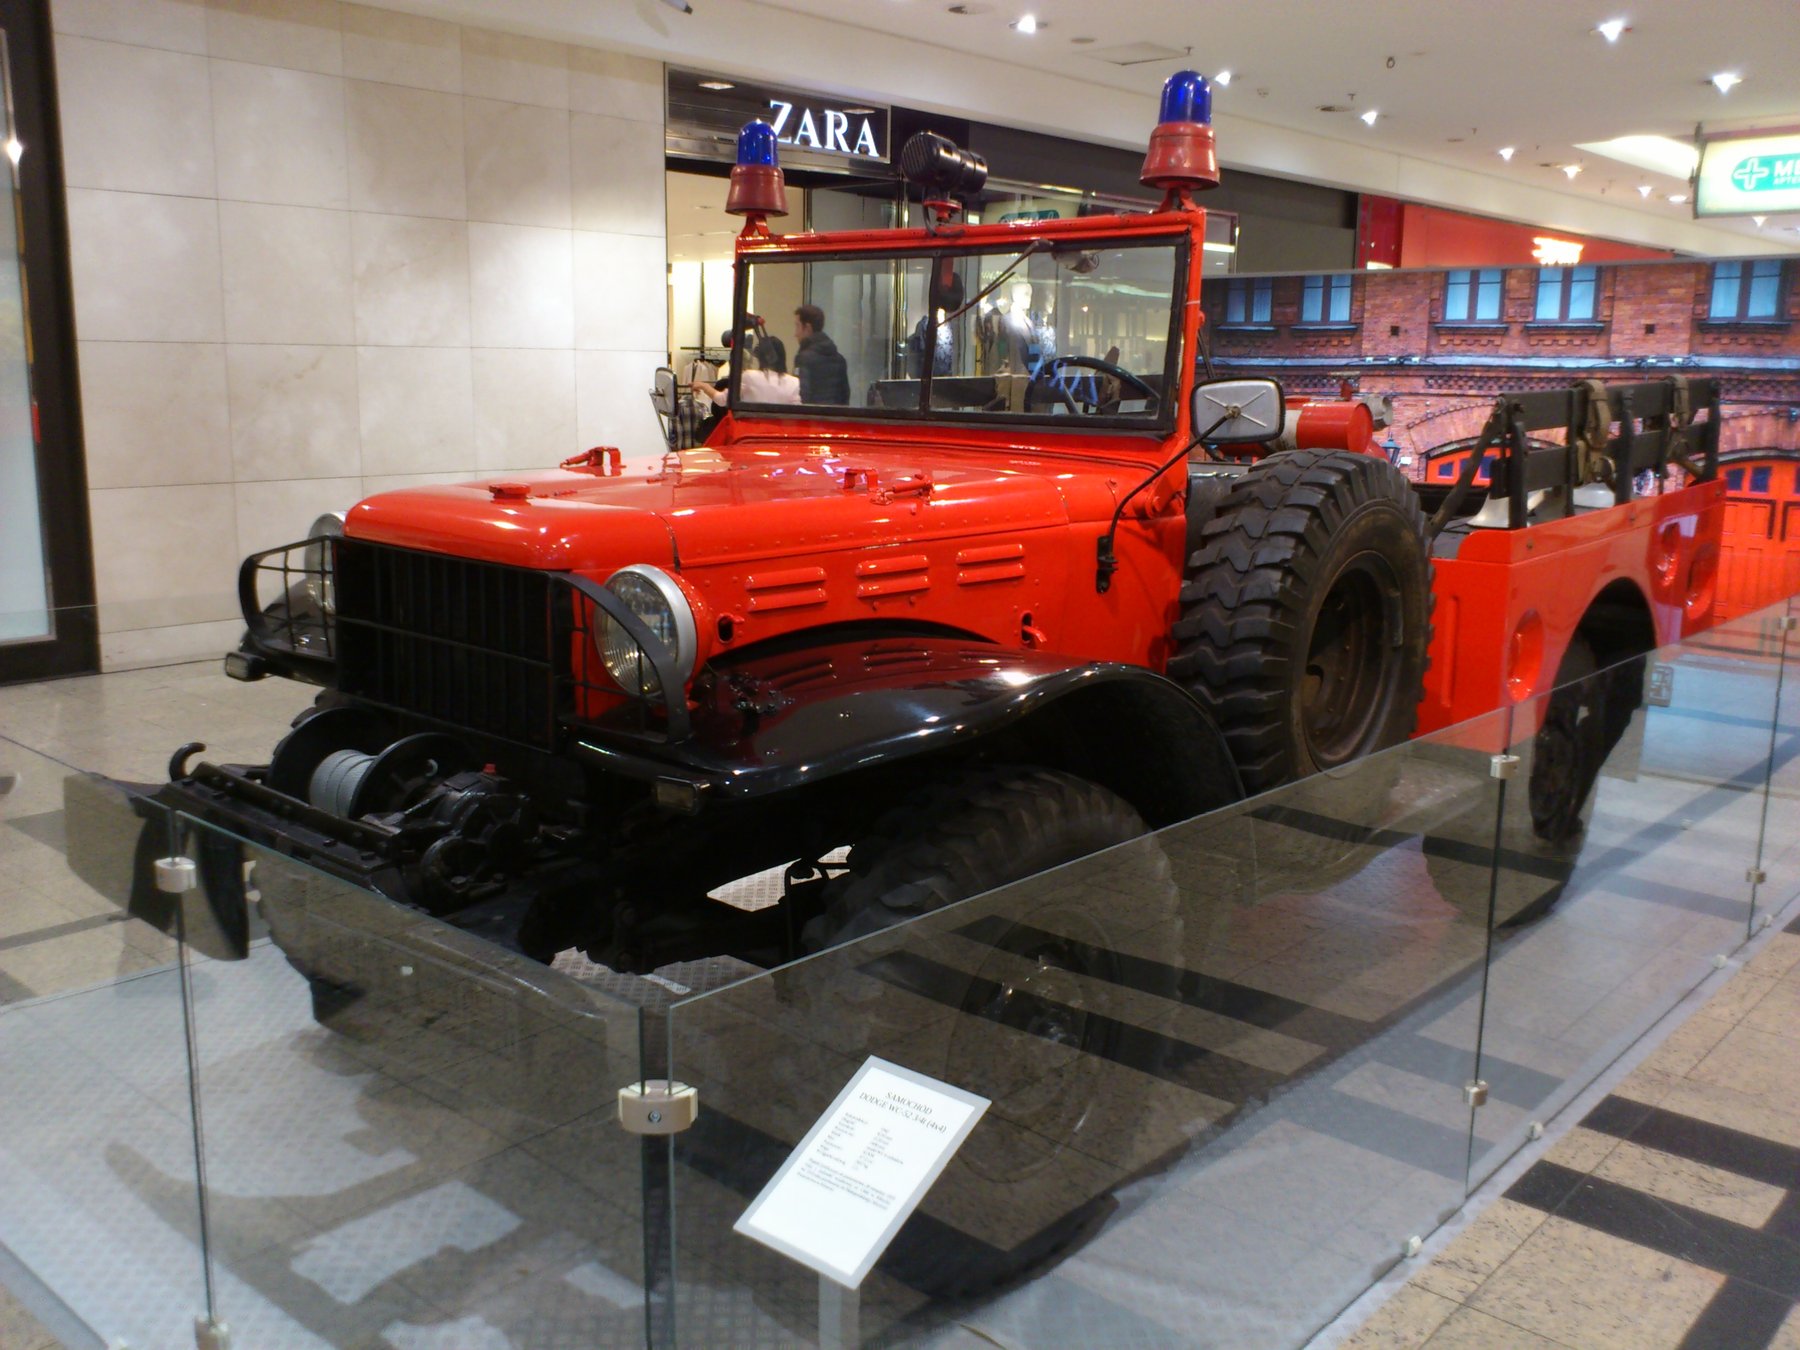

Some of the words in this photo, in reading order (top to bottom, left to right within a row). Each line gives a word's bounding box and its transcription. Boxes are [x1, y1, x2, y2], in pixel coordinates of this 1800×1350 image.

[770, 100, 880, 157] ZARA
[859, 1092, 887, 1108] DODGE
[926, 1120, 947, 1134] (4x4)
[886, 1092, 933, 1114] SAMOCHÓD
